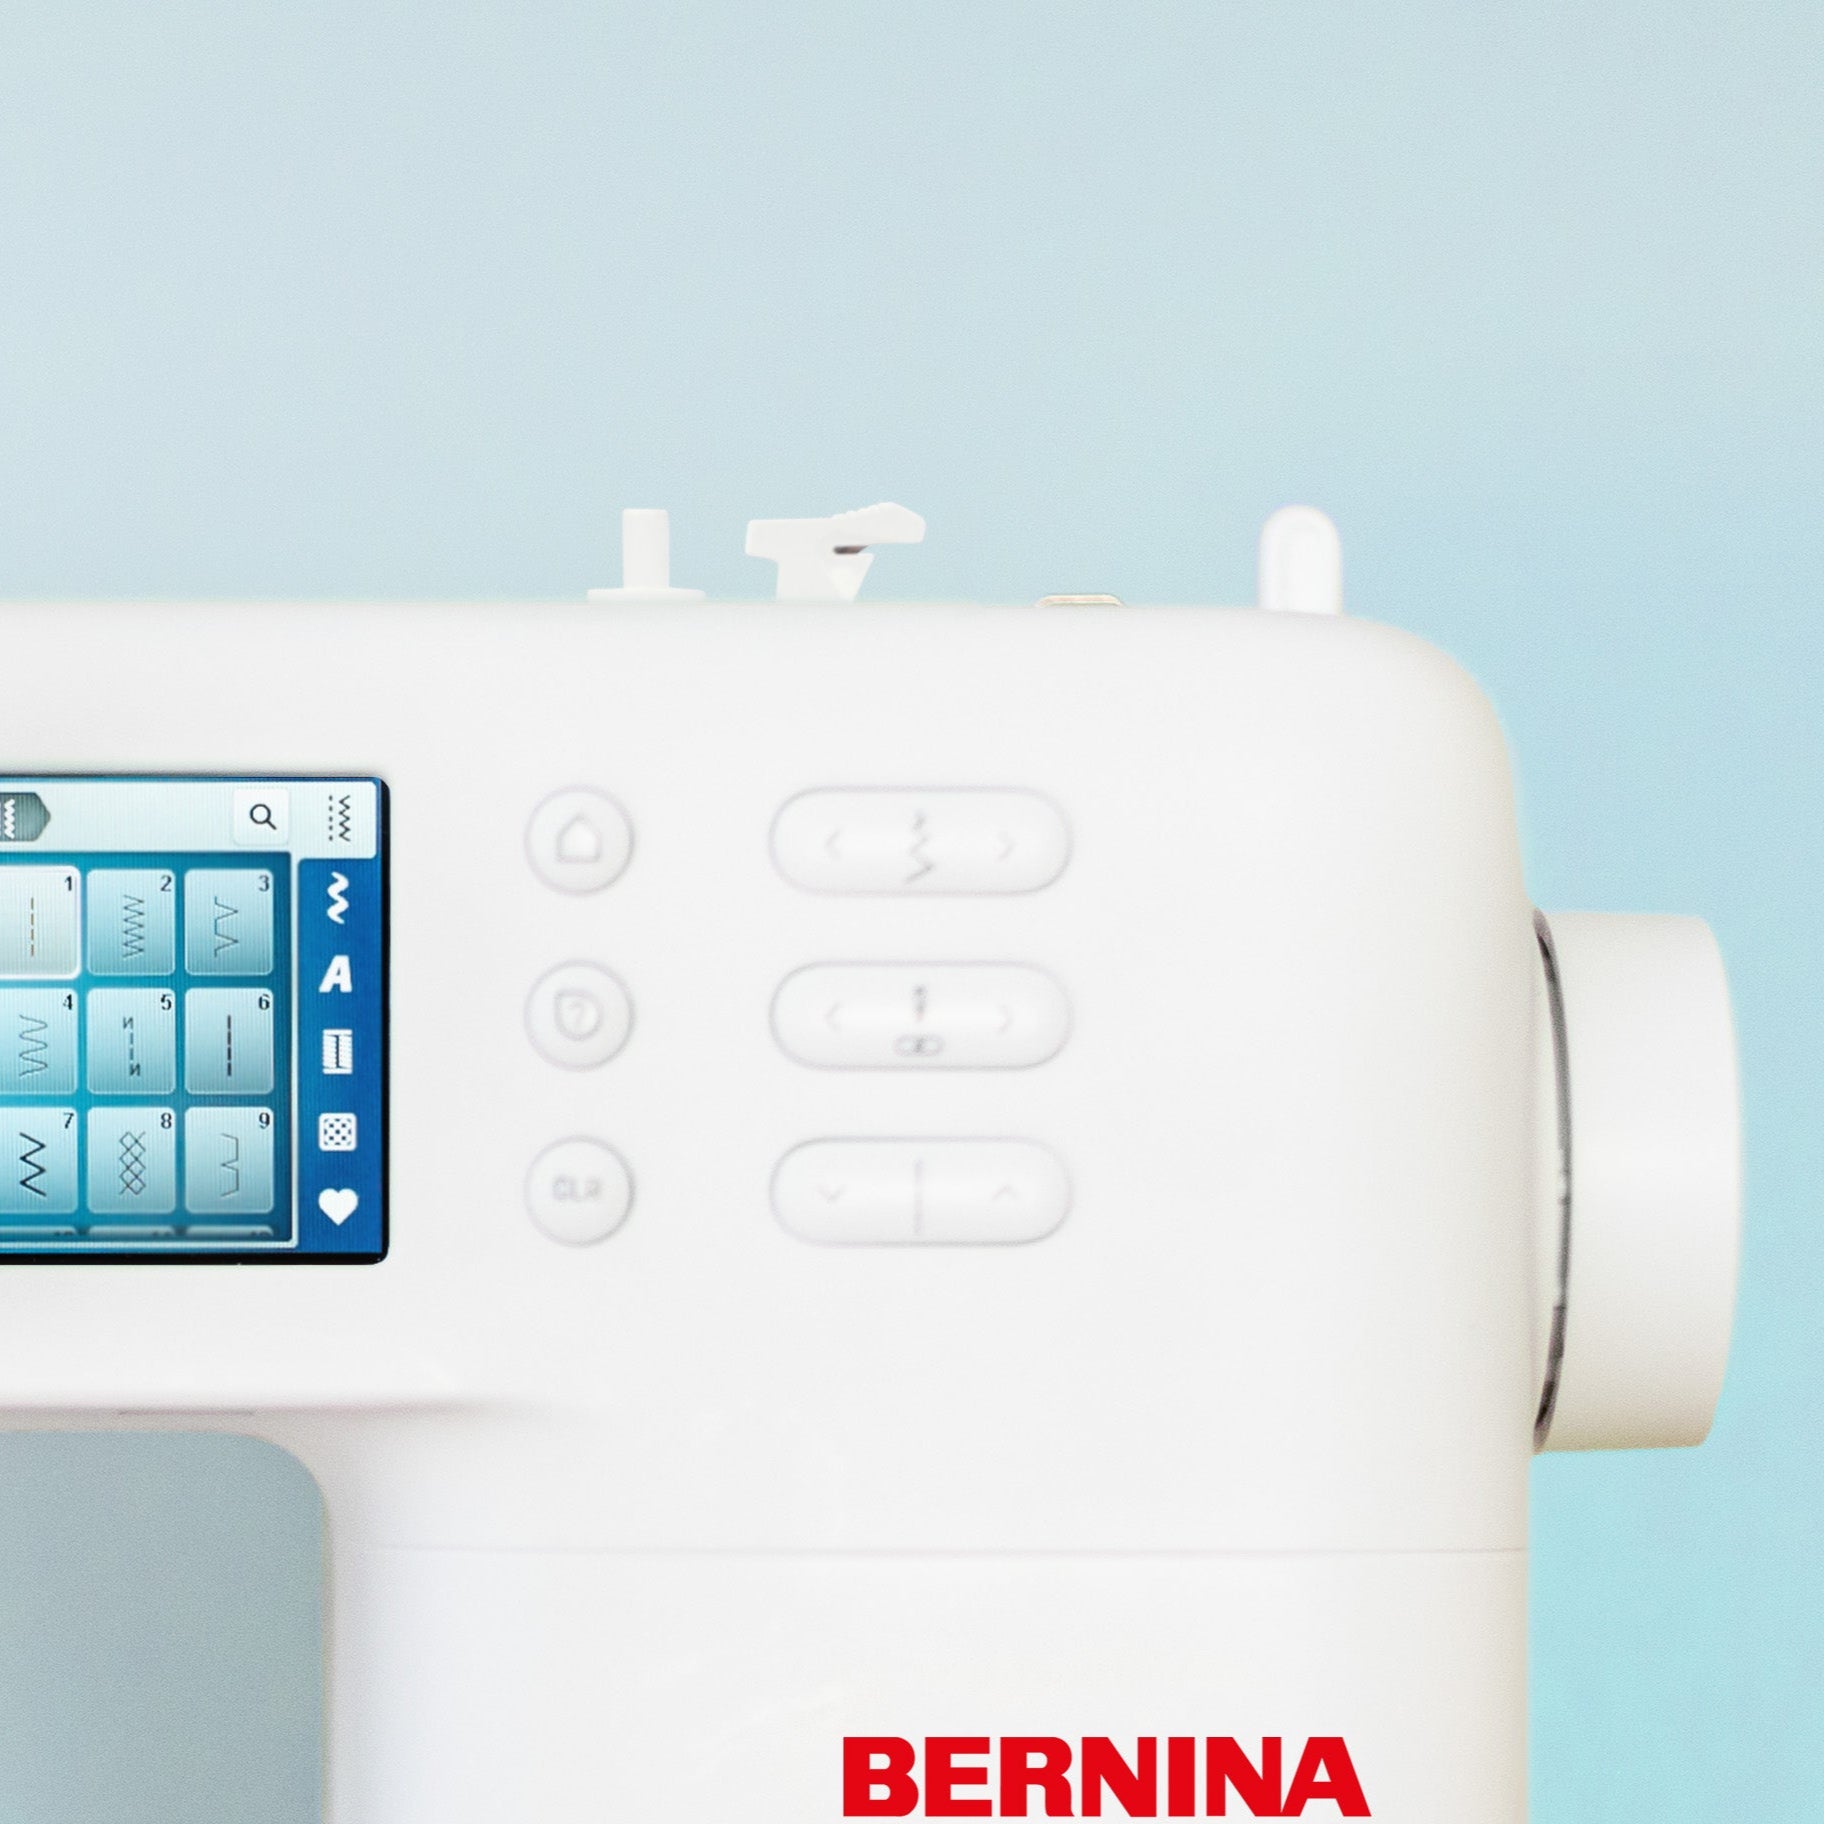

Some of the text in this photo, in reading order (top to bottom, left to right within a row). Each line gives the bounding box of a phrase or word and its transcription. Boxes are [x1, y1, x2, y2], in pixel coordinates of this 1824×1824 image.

[64, 875, 73, 891] 1
[160, 875, 173, 892] 2
[258, 875, 271, 892] 3
[63, 994, 73, 1011] 4
[160, 994, 172, 1011] 5
[258, 994, 271, 1011] 6
[63, 1112, 75, 1130] 7
[160, 1112, 172, 1130] 8
[258, 1112, 271, 1130] 9
[843, 1736, 1371, 1817] BERNINA
